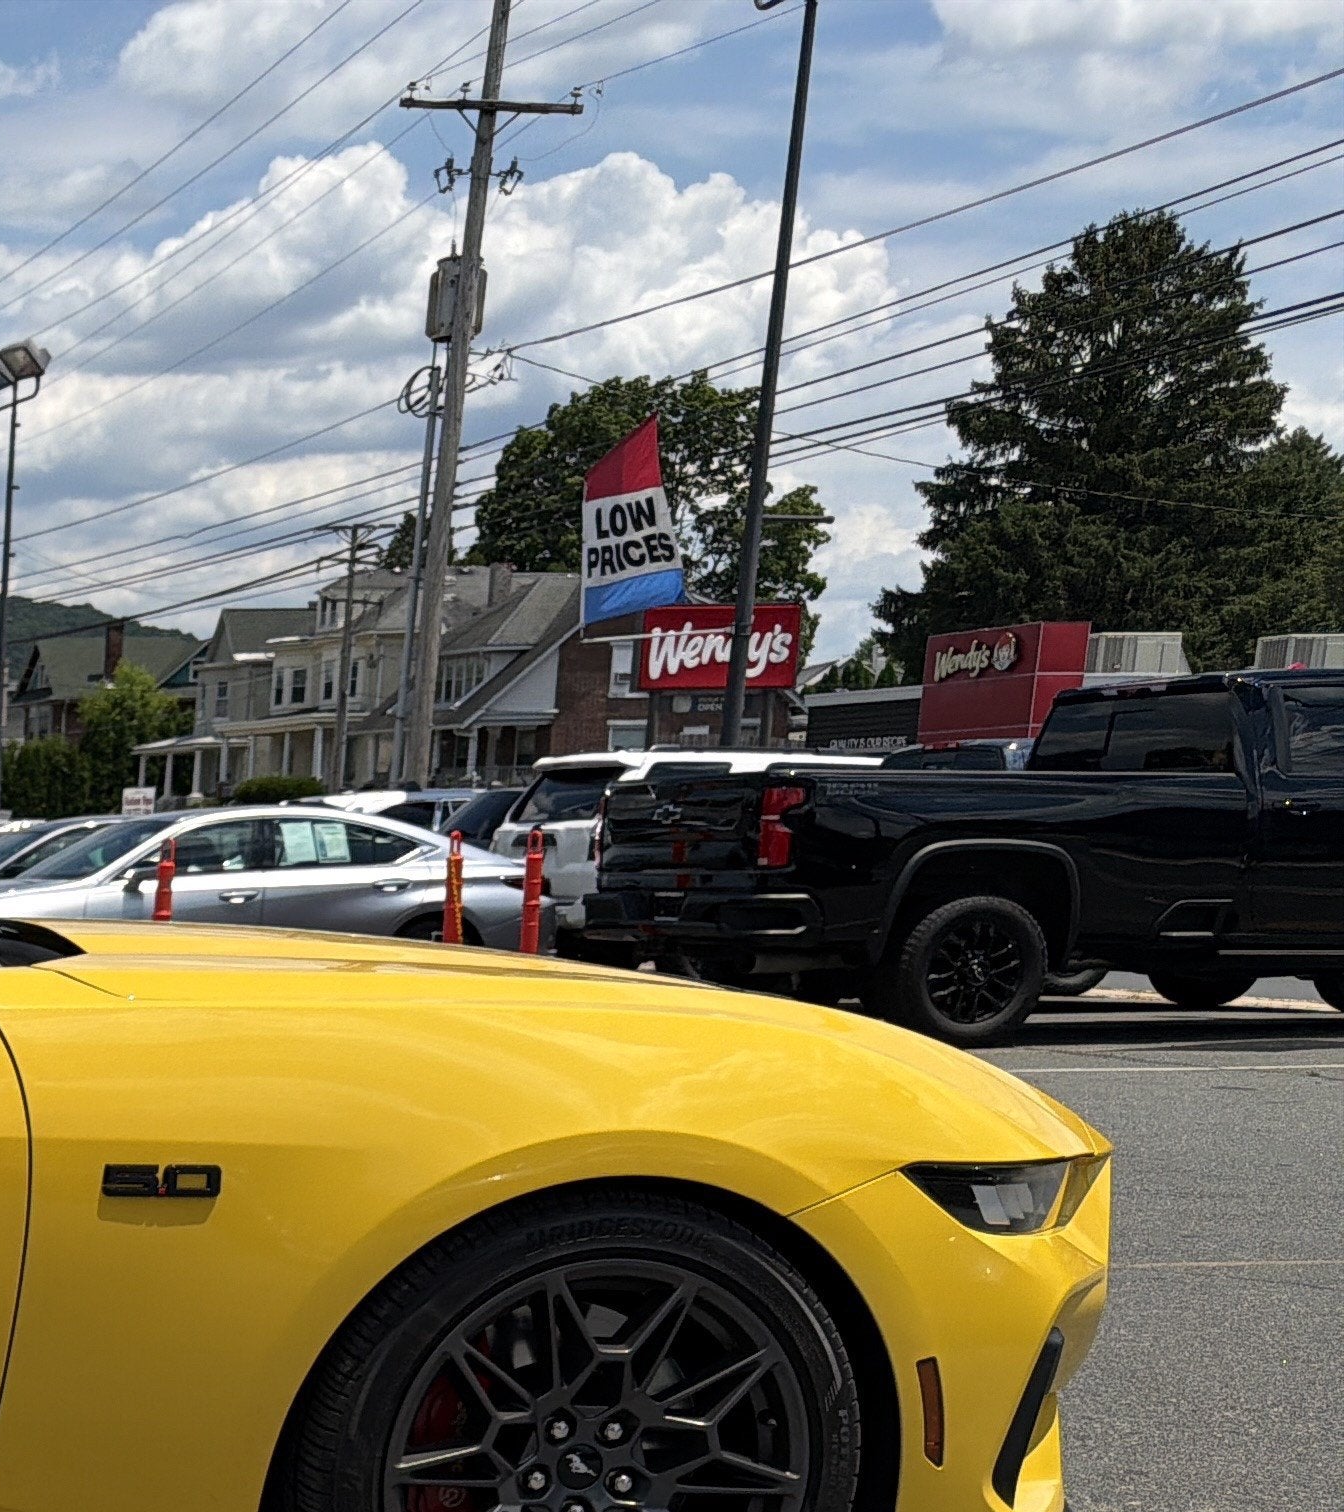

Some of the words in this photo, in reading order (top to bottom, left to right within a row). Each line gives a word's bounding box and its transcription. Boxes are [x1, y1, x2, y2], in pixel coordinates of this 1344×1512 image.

[595, 497, 656, 540] LOW
[587, 532, 675, 579] PRICES
[934, 639, 991, 682] Wendy's
[102, 1163, 223, 1198] 5.0
